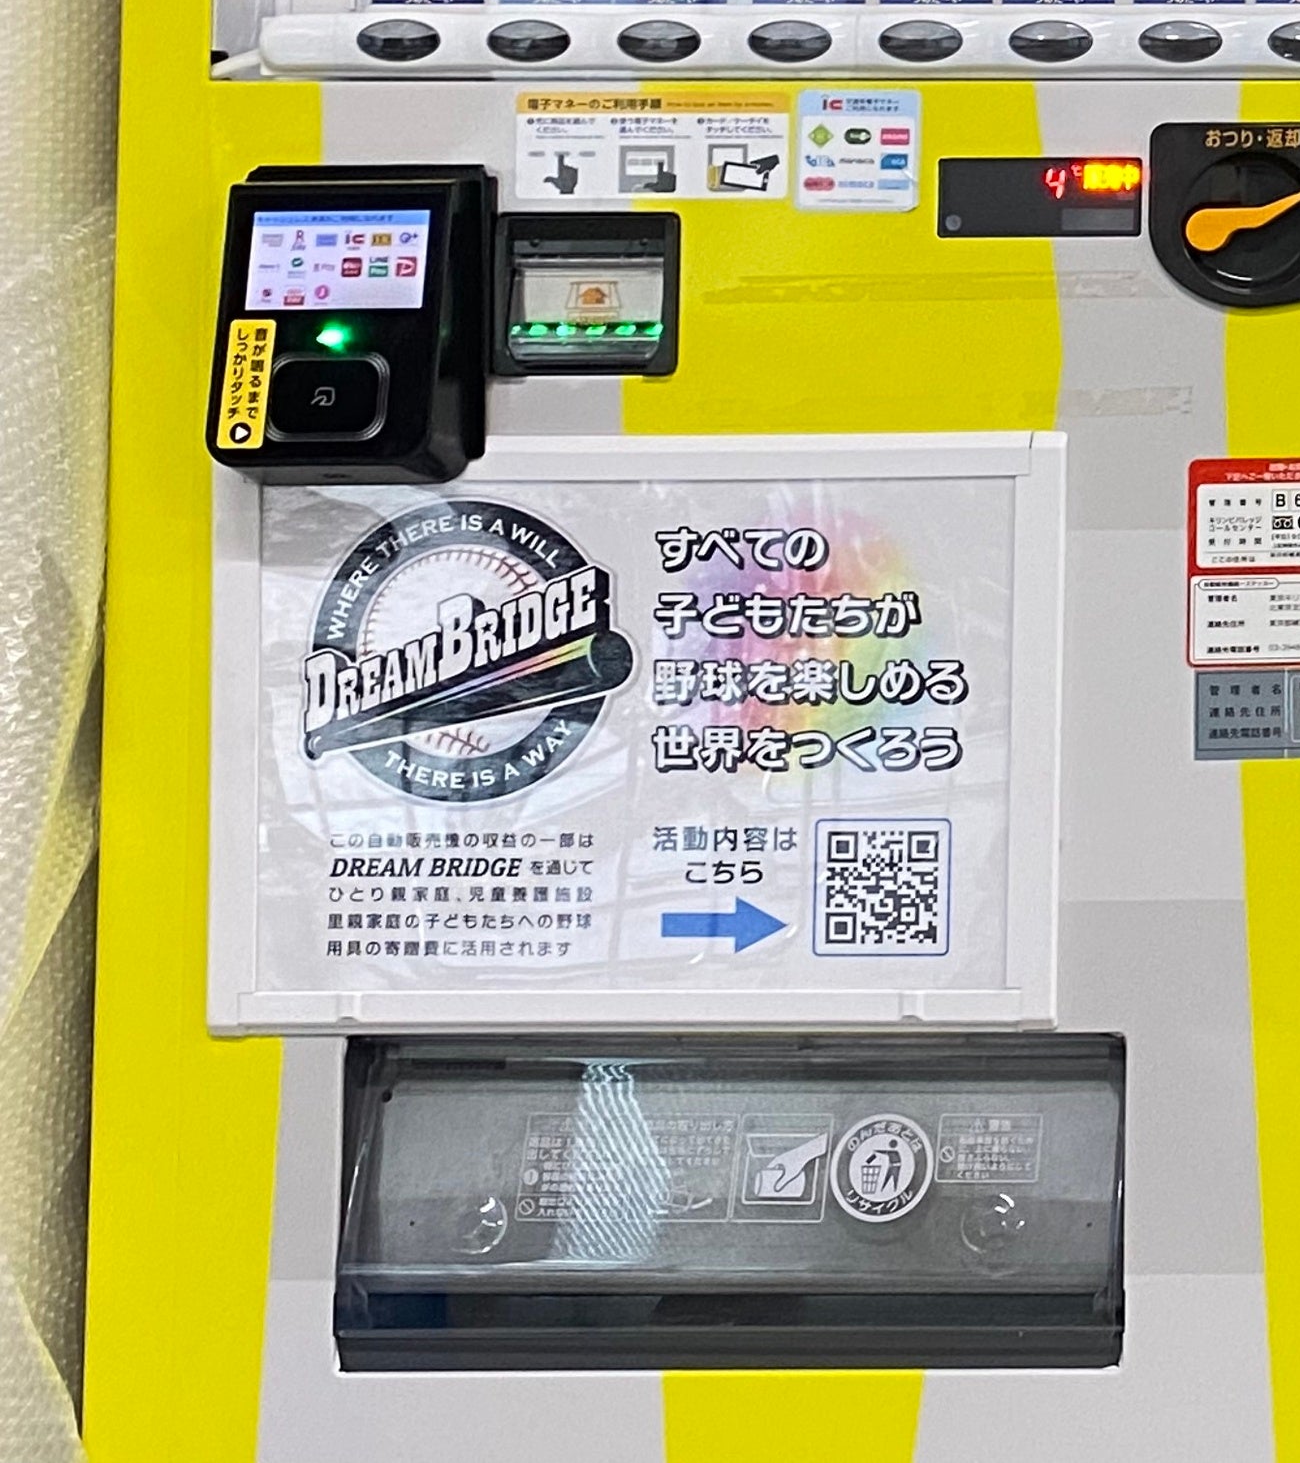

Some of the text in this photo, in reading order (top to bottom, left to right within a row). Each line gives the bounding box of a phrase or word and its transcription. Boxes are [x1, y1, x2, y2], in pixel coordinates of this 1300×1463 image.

[1205, 129, 1300, 148] おつり・返却
[228, 329, 248, 418] しっかりタッチ
[656, 527, 829, 572] すべての
[327, 515, 560, 640] WHERE THERE IS A WILL
[654, 592, 921, 637] 子どもたちが
[653, 660, 969, 705] 野球を楽しめる
[384, 719, 573, 789] THERE IS A WAY
[652, 726, 964, 773] 世界をつくろう
